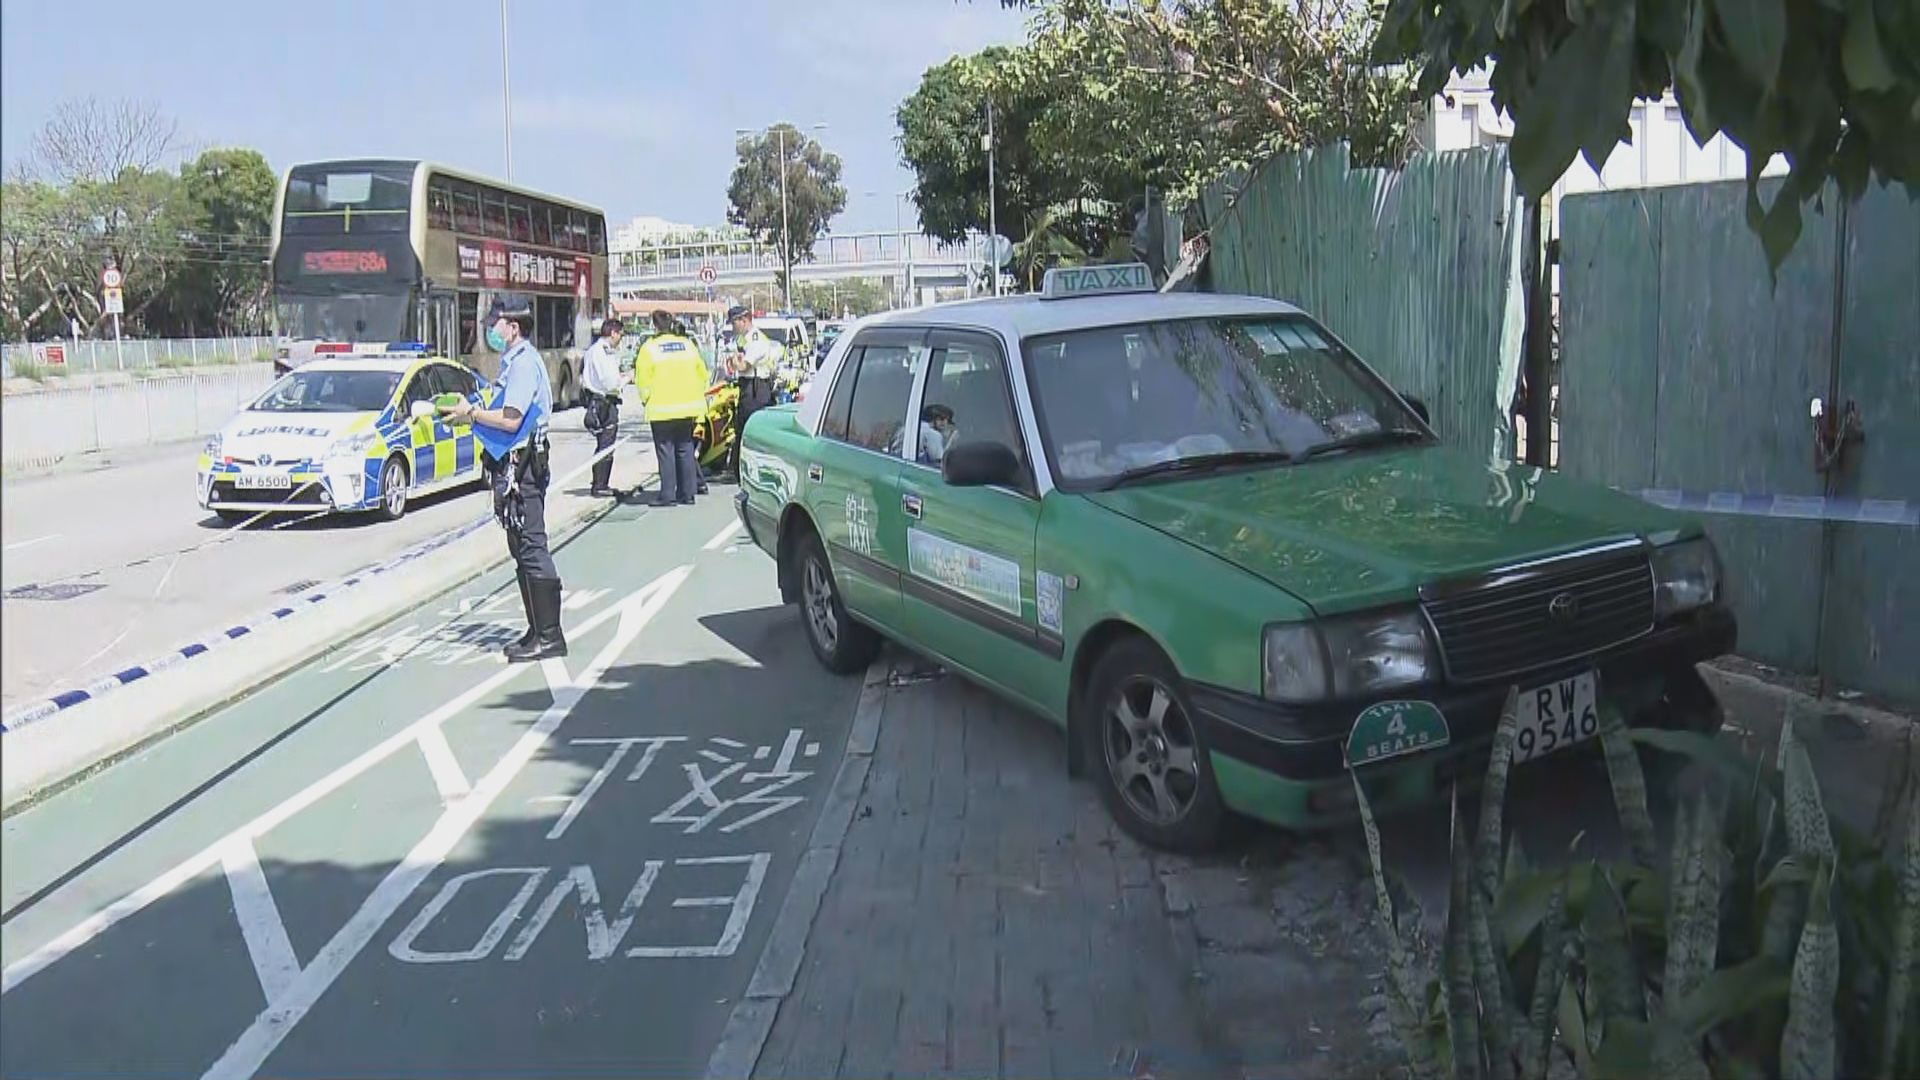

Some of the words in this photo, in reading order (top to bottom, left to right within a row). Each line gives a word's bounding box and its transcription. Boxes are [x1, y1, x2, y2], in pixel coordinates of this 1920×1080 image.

[360, 251, 387, 272] 68A
[1058, 265, 1146, 291] TAXI
[238, 475, 253, 487] AM
[257, 475, 288, 487] 6500
[847, 521, 871, 557] TAXI
[1536, 680, 1575, 722] RW
[1387, 712, 1406, 736] 4
[1518, 703, 1597, 759] 9546
[1367, 731, 1429, 757] SEATS
[388, 853, 771, 963] END
